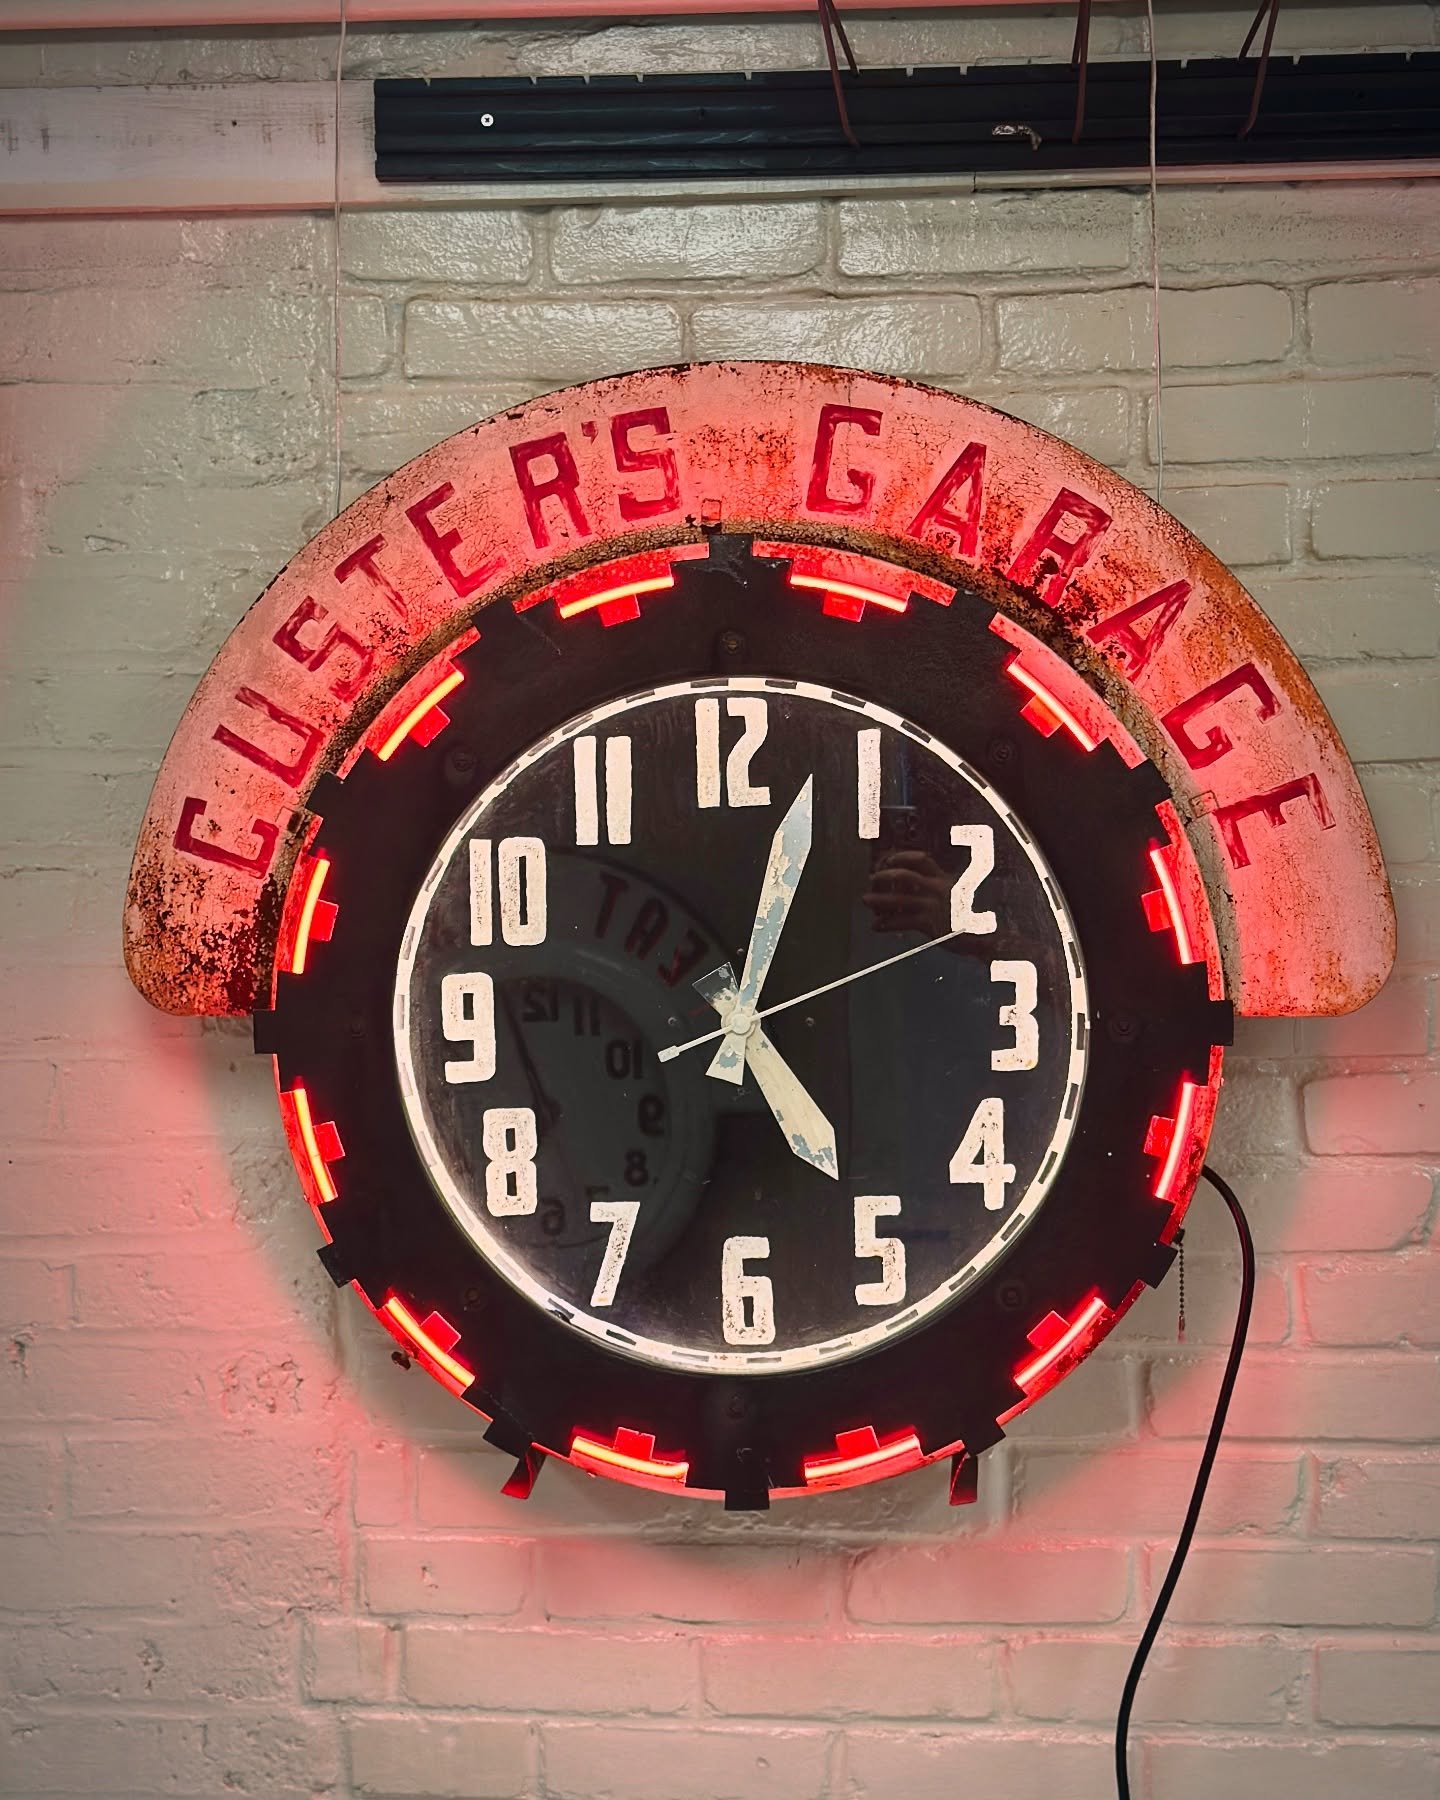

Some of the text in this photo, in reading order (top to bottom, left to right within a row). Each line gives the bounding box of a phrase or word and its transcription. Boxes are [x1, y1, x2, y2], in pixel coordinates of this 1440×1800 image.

[173, 403, 1337, 879] CUSTER'S GARAGE
[573, 735, 633, 845] 11
[695, 697, 771, 809] 12
[857, 728, 881, 839] 1
[469, 836, 547, 947] 10
[950, 824, 997, 936] 2
[442, 972, 496, 1084] 9
[990, 960, 1039, 1072] 3
[483, 1107, 538, 1218] 8
[949, 1098, 1016, 1210] 4
[590, 1201, 640, 1308] 7
[721, 1236, 776, 1346] 6
[853, 1196, 907, 1306] 5
